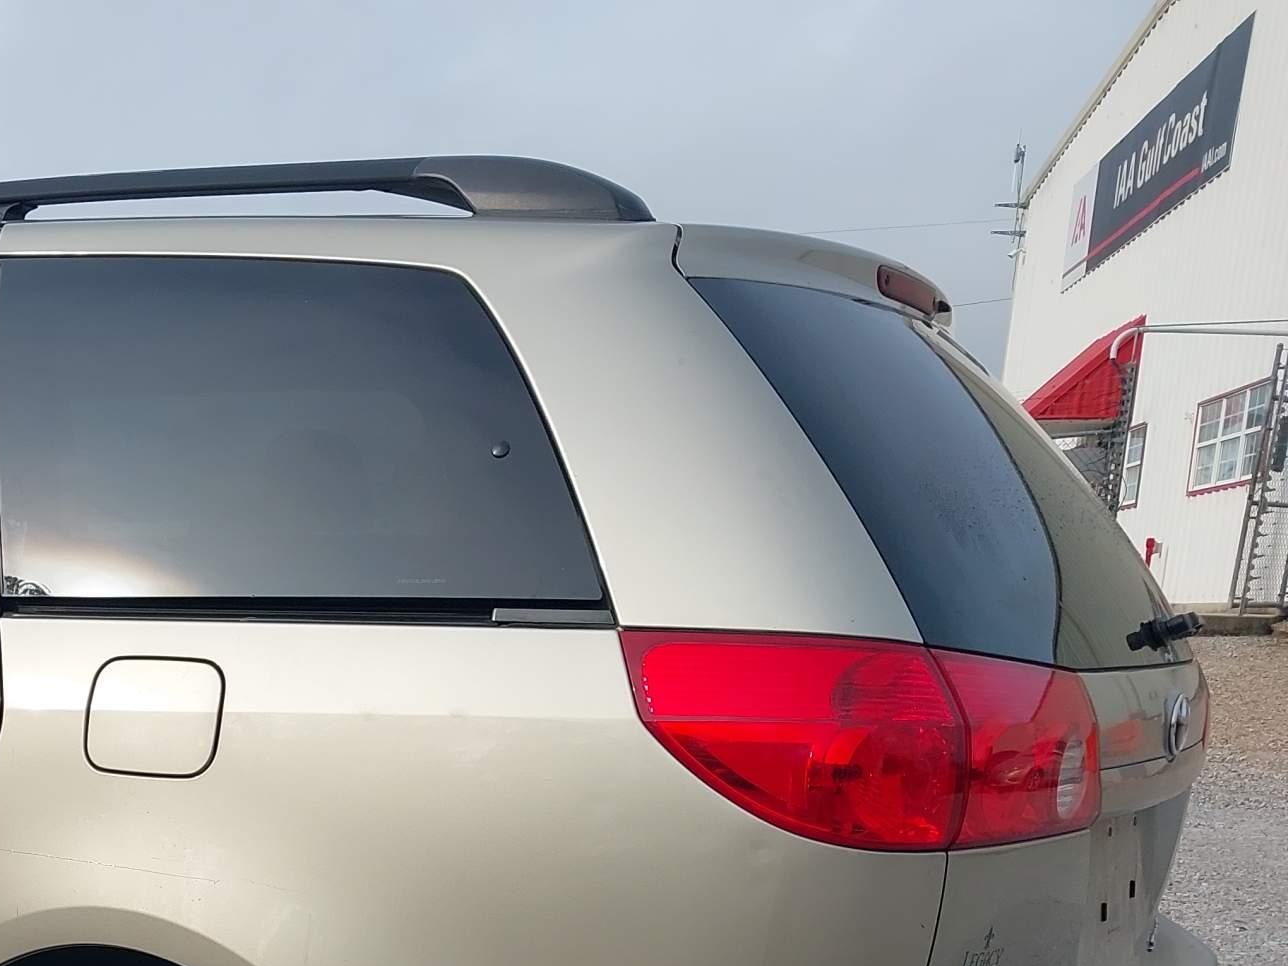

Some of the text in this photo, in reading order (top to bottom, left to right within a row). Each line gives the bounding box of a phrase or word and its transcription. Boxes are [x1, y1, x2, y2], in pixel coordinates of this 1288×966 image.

[1113, 91, 1208, 209] IAA Gulf Coast
